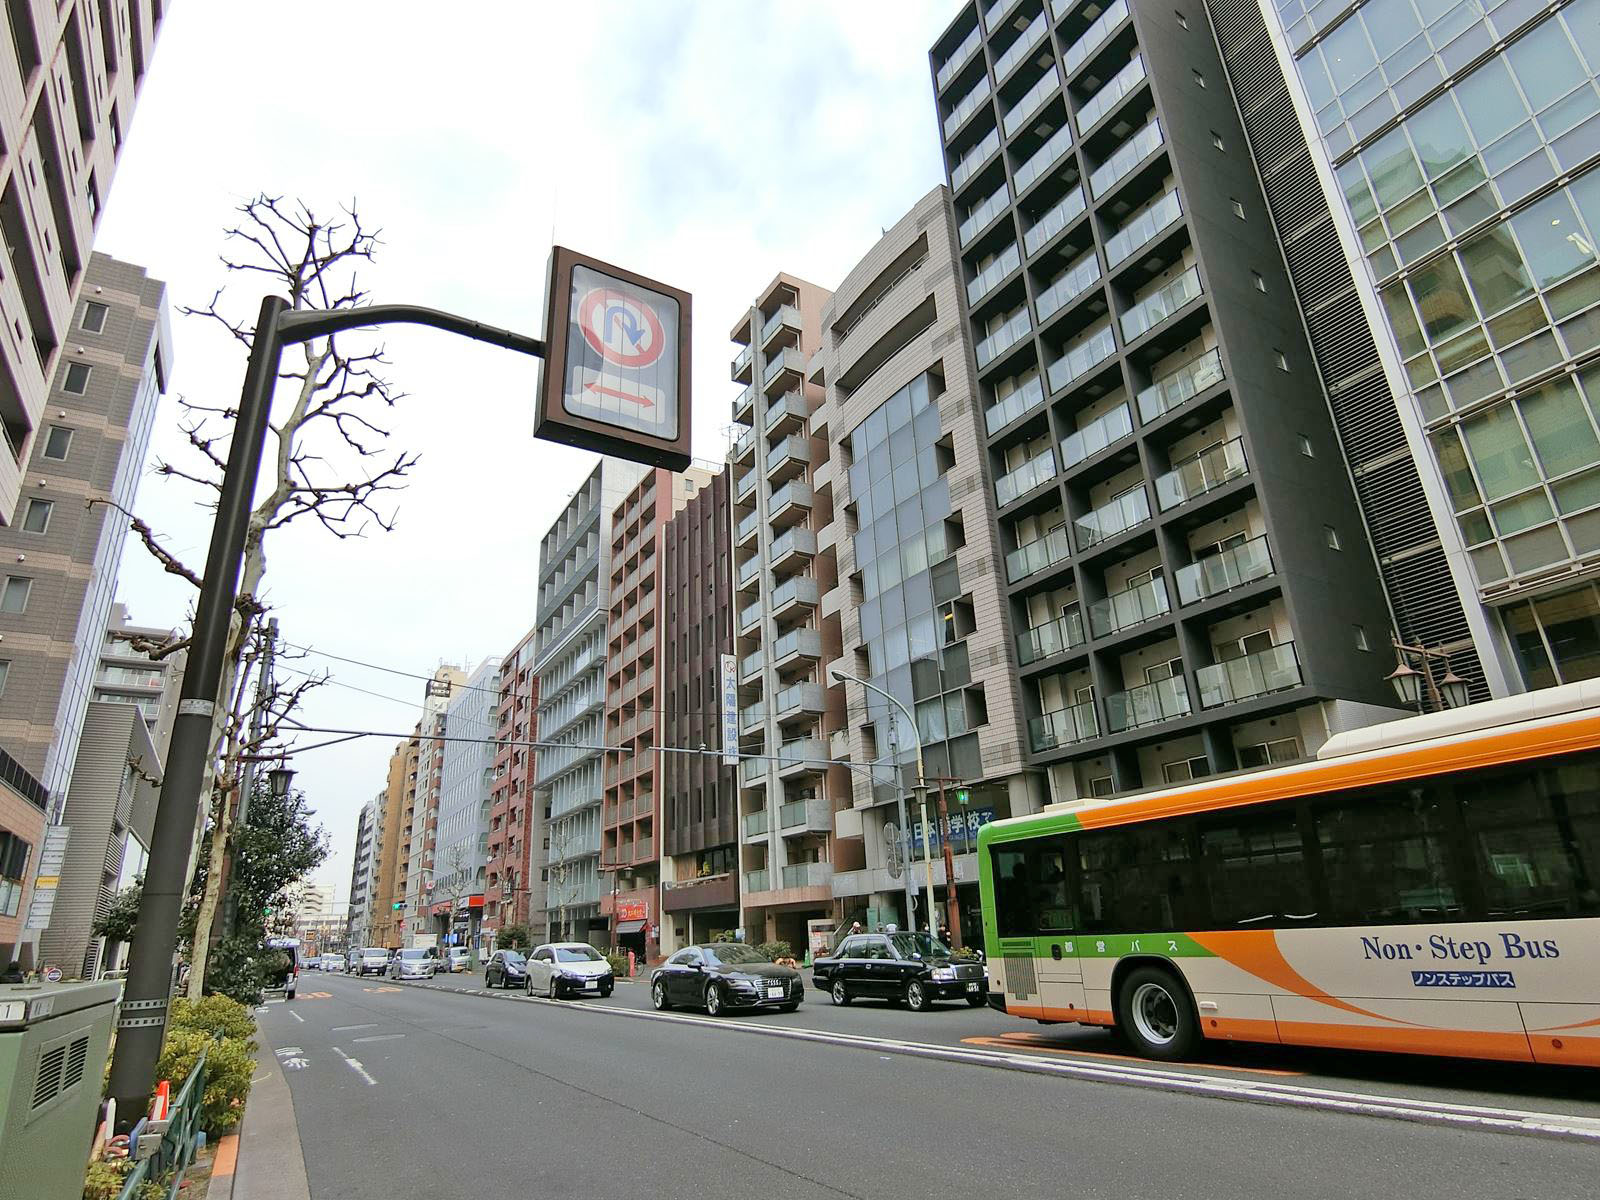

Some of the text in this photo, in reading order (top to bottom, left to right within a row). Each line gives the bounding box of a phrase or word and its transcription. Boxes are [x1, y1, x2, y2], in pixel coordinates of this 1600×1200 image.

[1499, 933, 1560, 959] Bus
[1414, 973, 1514, 987] ノンステップバス
